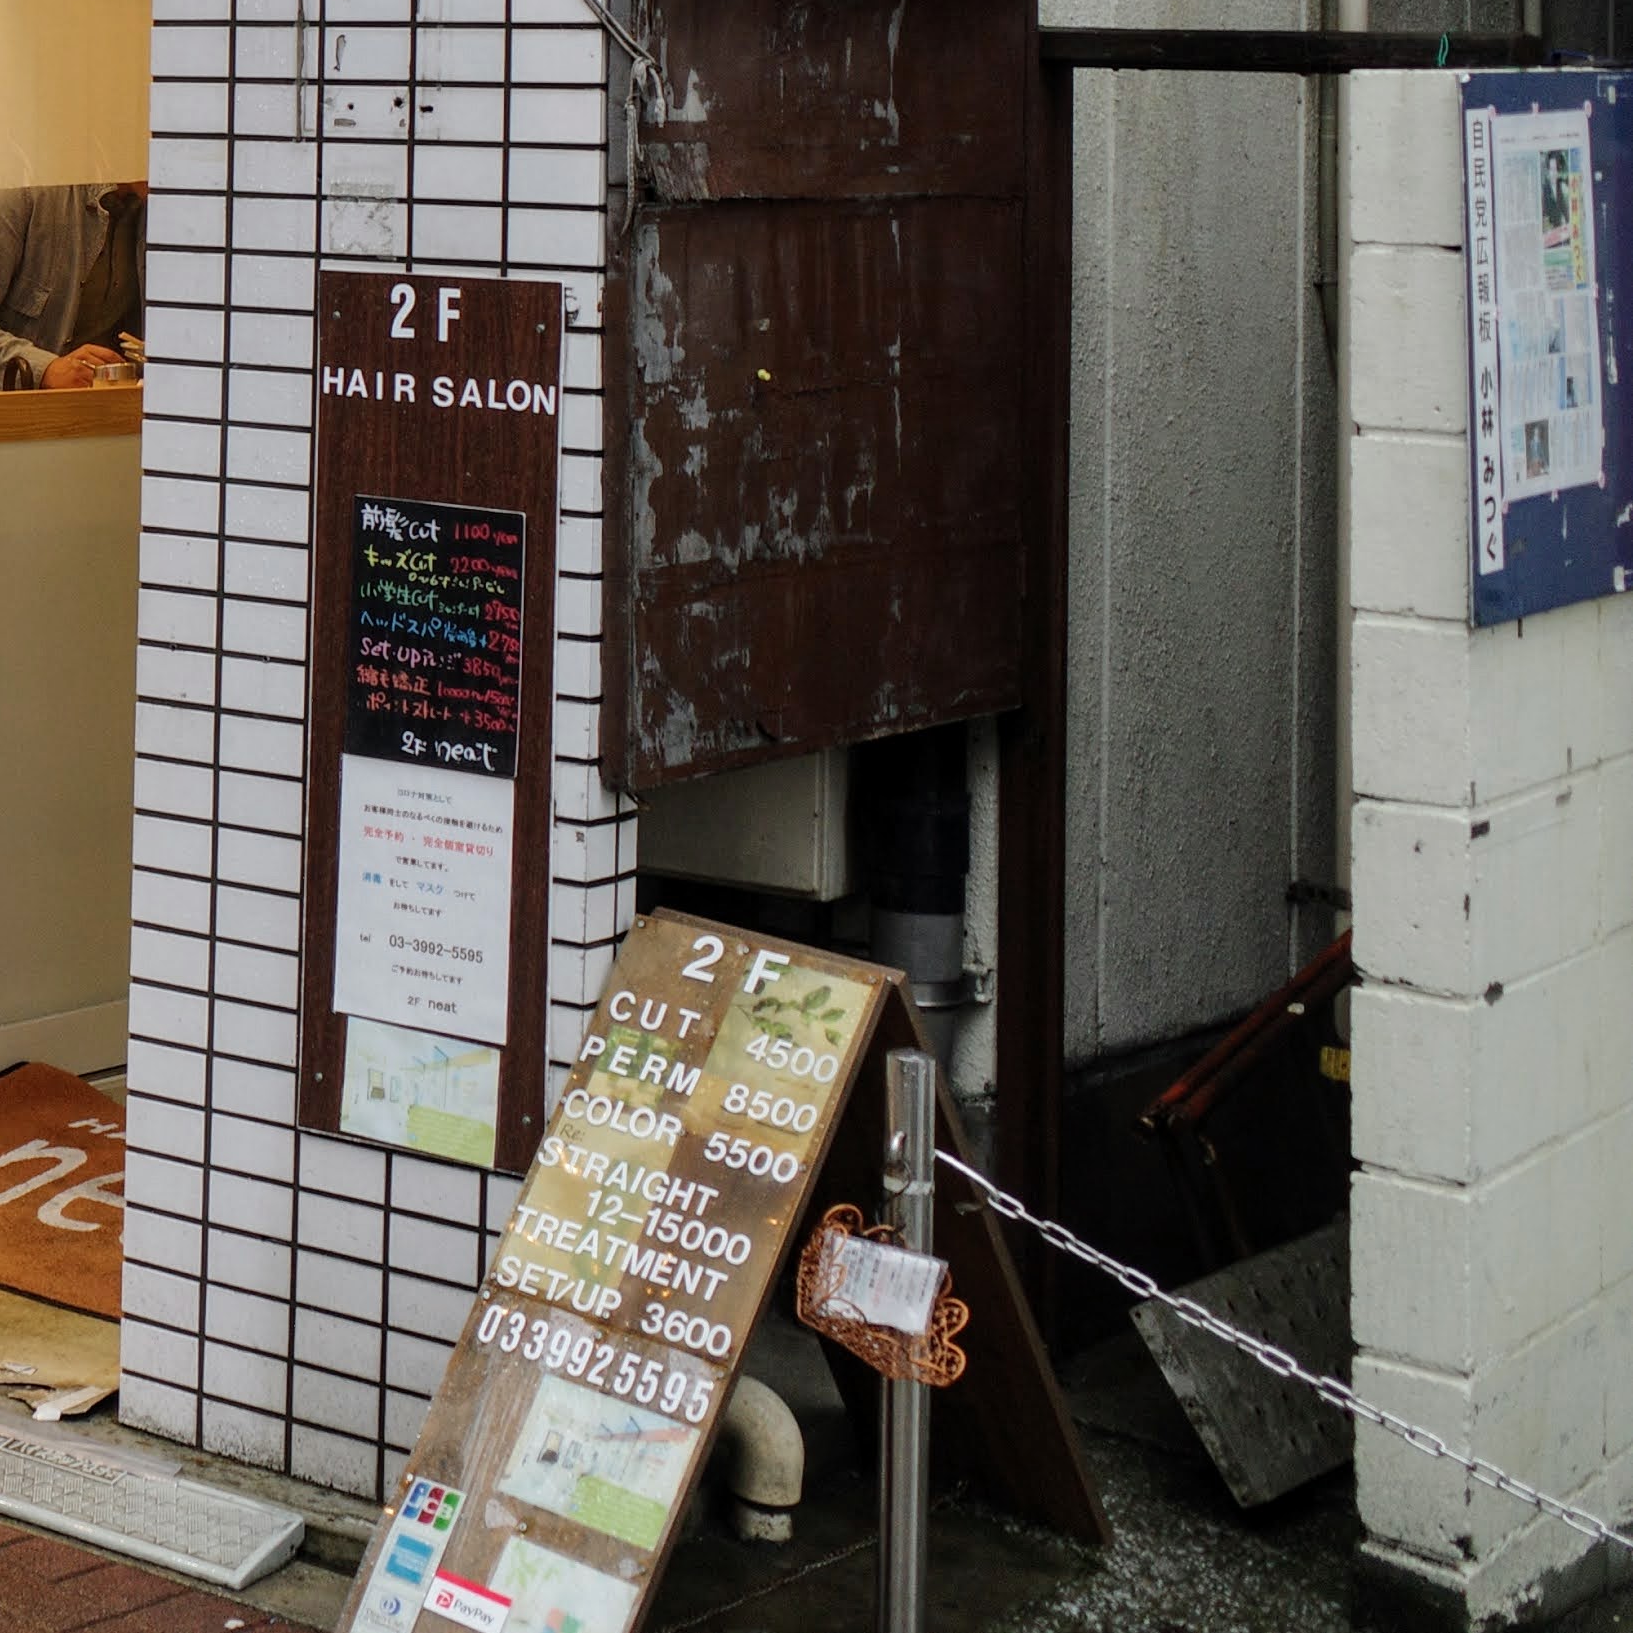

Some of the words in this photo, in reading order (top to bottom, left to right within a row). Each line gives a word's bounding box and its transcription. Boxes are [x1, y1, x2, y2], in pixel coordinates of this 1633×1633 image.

[1471, 119, 1492, 344] 自民党広報板
[322, 365, 416, 404] HAIR
[432, 375, 557, 416] SALON
[1480, 365, 1495, 438] 小林
[1481, 455, 1499, 563] みつぐ
[434, 740, 499, 772] neat
[397, 788, 454, 805] コロナ対策として
[361, 871, 384, 885] 消毒
[416, 880, 446, 895] マスク
[453, 890, 477, 902] つけて
[395, 855, 450, 873] で営業してます。
[392, 901, 443, 918] お待ちしてます
[359, 933, 372, 943] tel
[388, 934, 485, 964] 03-3992-5595
[391, 965, 463, 986] ご予約お待ちしてます
[406, 996, 422, 1007] 2F
[427, 999, 459, 1015] neat
[608, 990, 702, 1041] CUT
[744, 1034, 841, 1084] 4500
[579, 1035, 702, 1097] PERM
[721, 1081, 818, 1135] 8500
[562, 1088, 683, 1148] COLOR
[703, 1130, 800, 1185] 5500
[537, 1136, 720, 1218] STRAIGHT
[514, 1204, 729, 1304] TREATMENT
[639, 1303, 733, 1360] 3600
[476, 1303, 715, 1424] 0339925595
[453, 1598, 495, 1625] PayPay
